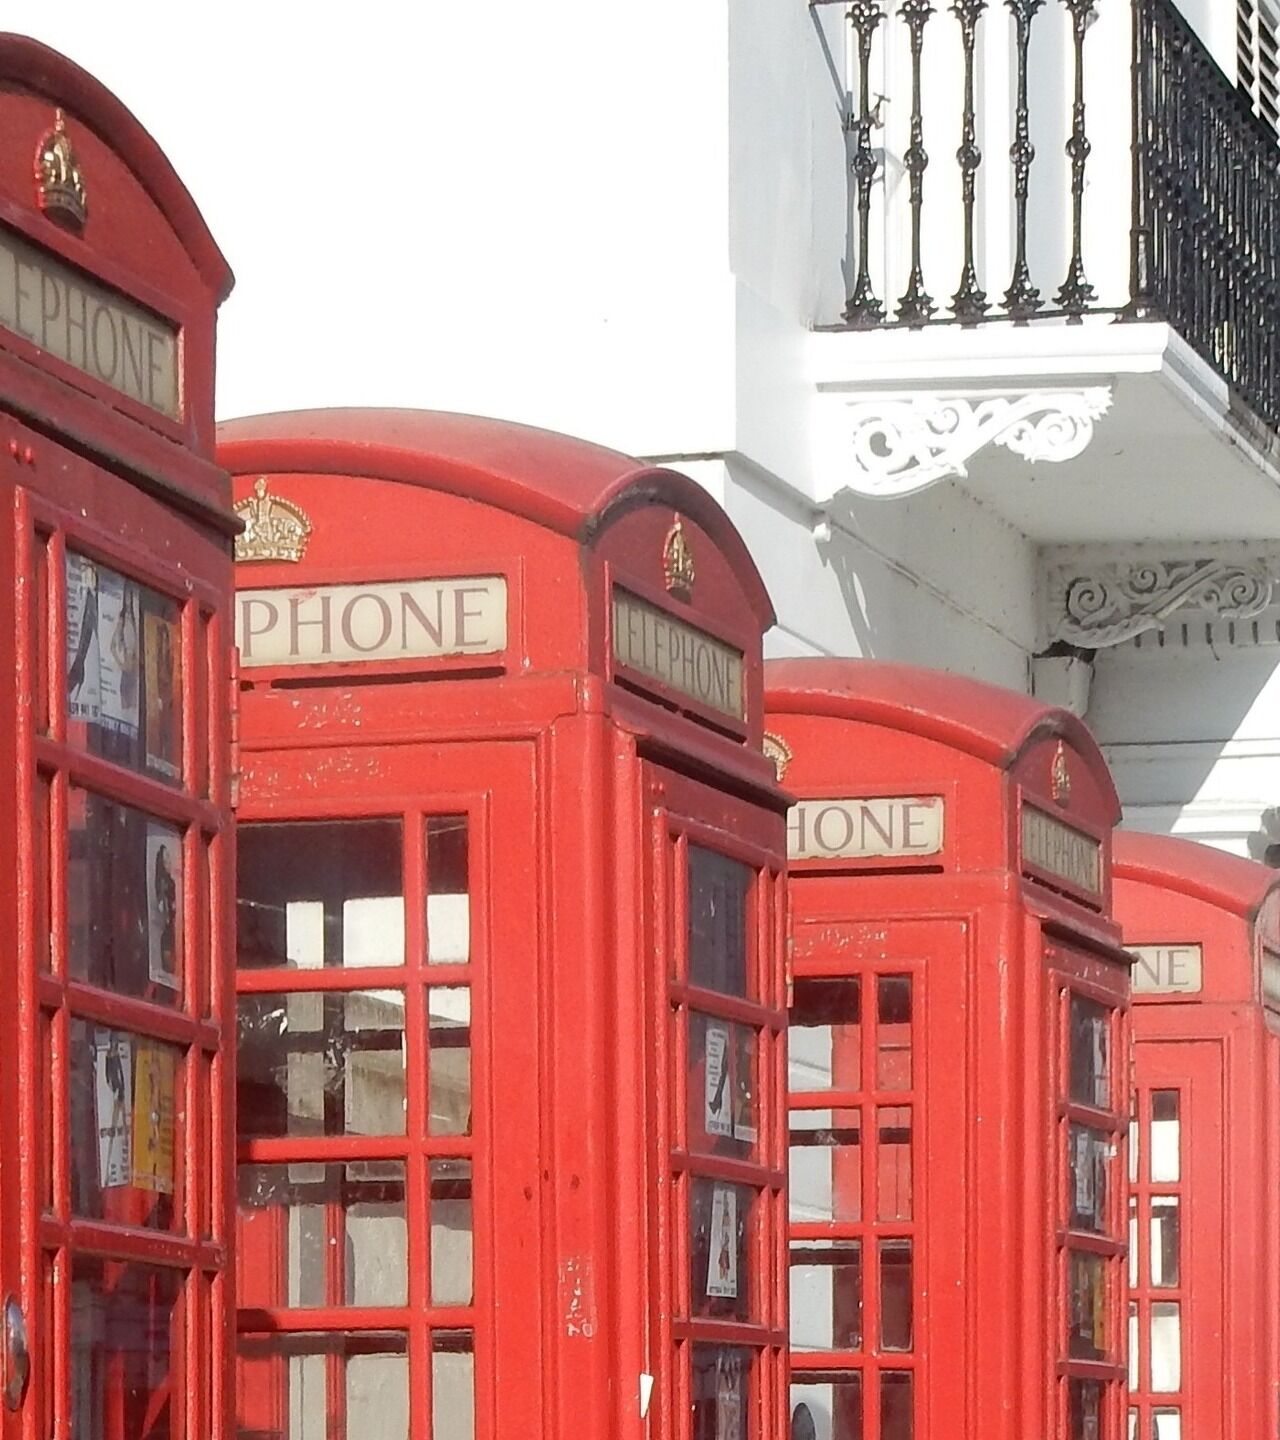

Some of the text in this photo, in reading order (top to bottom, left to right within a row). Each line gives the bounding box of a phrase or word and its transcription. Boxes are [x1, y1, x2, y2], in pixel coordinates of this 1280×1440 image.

[241, 587, 489, 657] PHONE
[614, 600, 736, 712] TELEPHONE
[1131, 949, 1189, 987] NE
